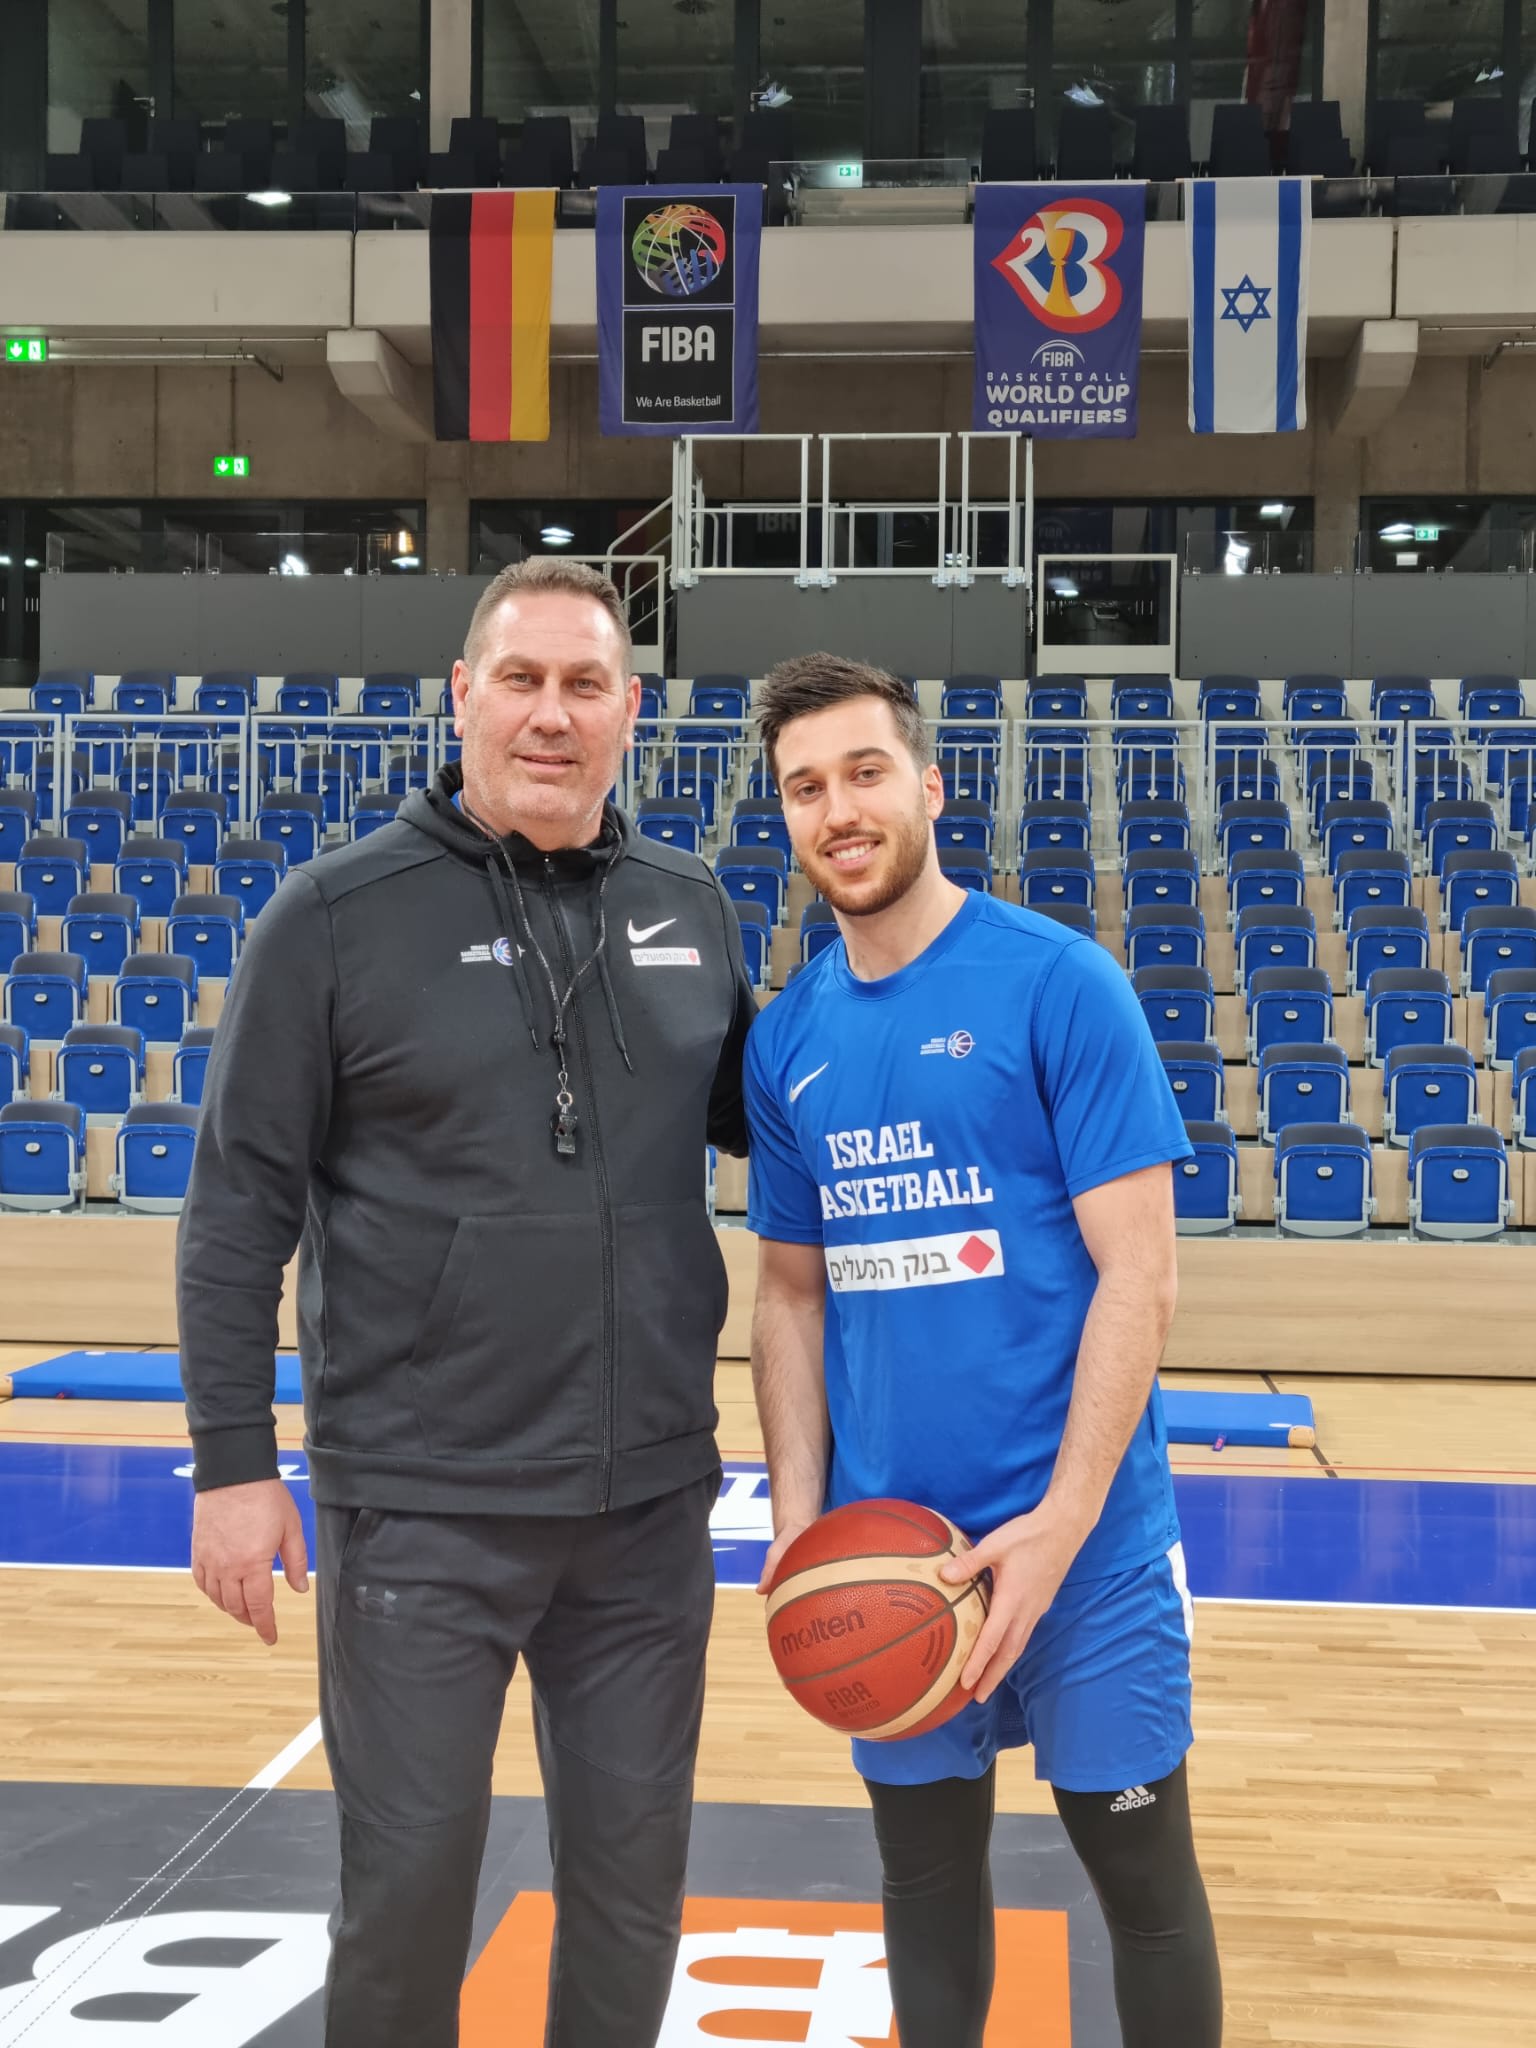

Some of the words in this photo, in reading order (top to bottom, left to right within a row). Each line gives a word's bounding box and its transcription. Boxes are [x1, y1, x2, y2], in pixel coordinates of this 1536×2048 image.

[641, 325, 715, 362] FIBA
[1041, 351, 1074, 367] FIBA
[986, 371, 1127, 382] BASKETBALL
[635, 396, 653, 408] We
[655, 396, 672, 408] Are
[673, 394, 722, 407] Basketball
[986, 384, 1075, 404] WORLD
[1081, 383, 1130, 404] CUP
[987, 408, 1127, 428] QUALIFIERS
[825, 1120, 934, 1170] ISRAEL
[820, 1166, 994, 1220] ASKETBALL
[902, 1252, 951, 1282] בנק
[781, 1609, 865, 1656] molten
[823, 1681, 872, 1710] FIBA
[1110, 1793, 1156, 1812] adidas
